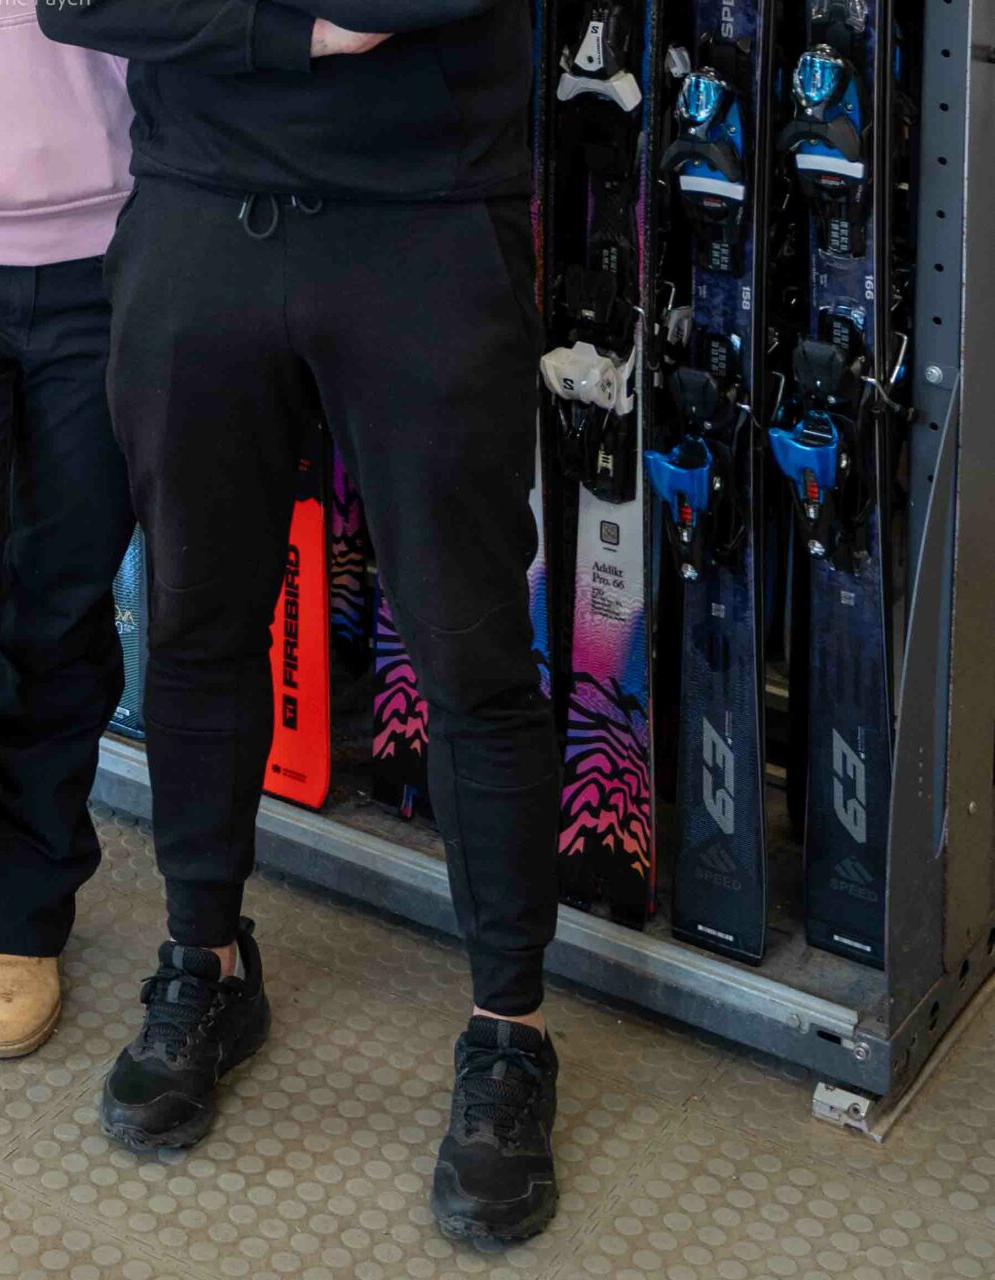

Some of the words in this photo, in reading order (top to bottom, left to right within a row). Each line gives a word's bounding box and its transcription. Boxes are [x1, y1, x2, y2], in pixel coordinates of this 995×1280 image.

[741, 285, 750, 310] 158
[864, 274, 874, 300] 166
[592, 561, 623, 578] Addikt
[612, 577, 625, 590] 66
[282, 544, 300, 690] FIREBIRD
[702, 716, 735, 835] 63
[832, 727, 867, 844] 63
[696, 872, 742, 891] SPEED
[828, 877, 879, 903] SPEED
